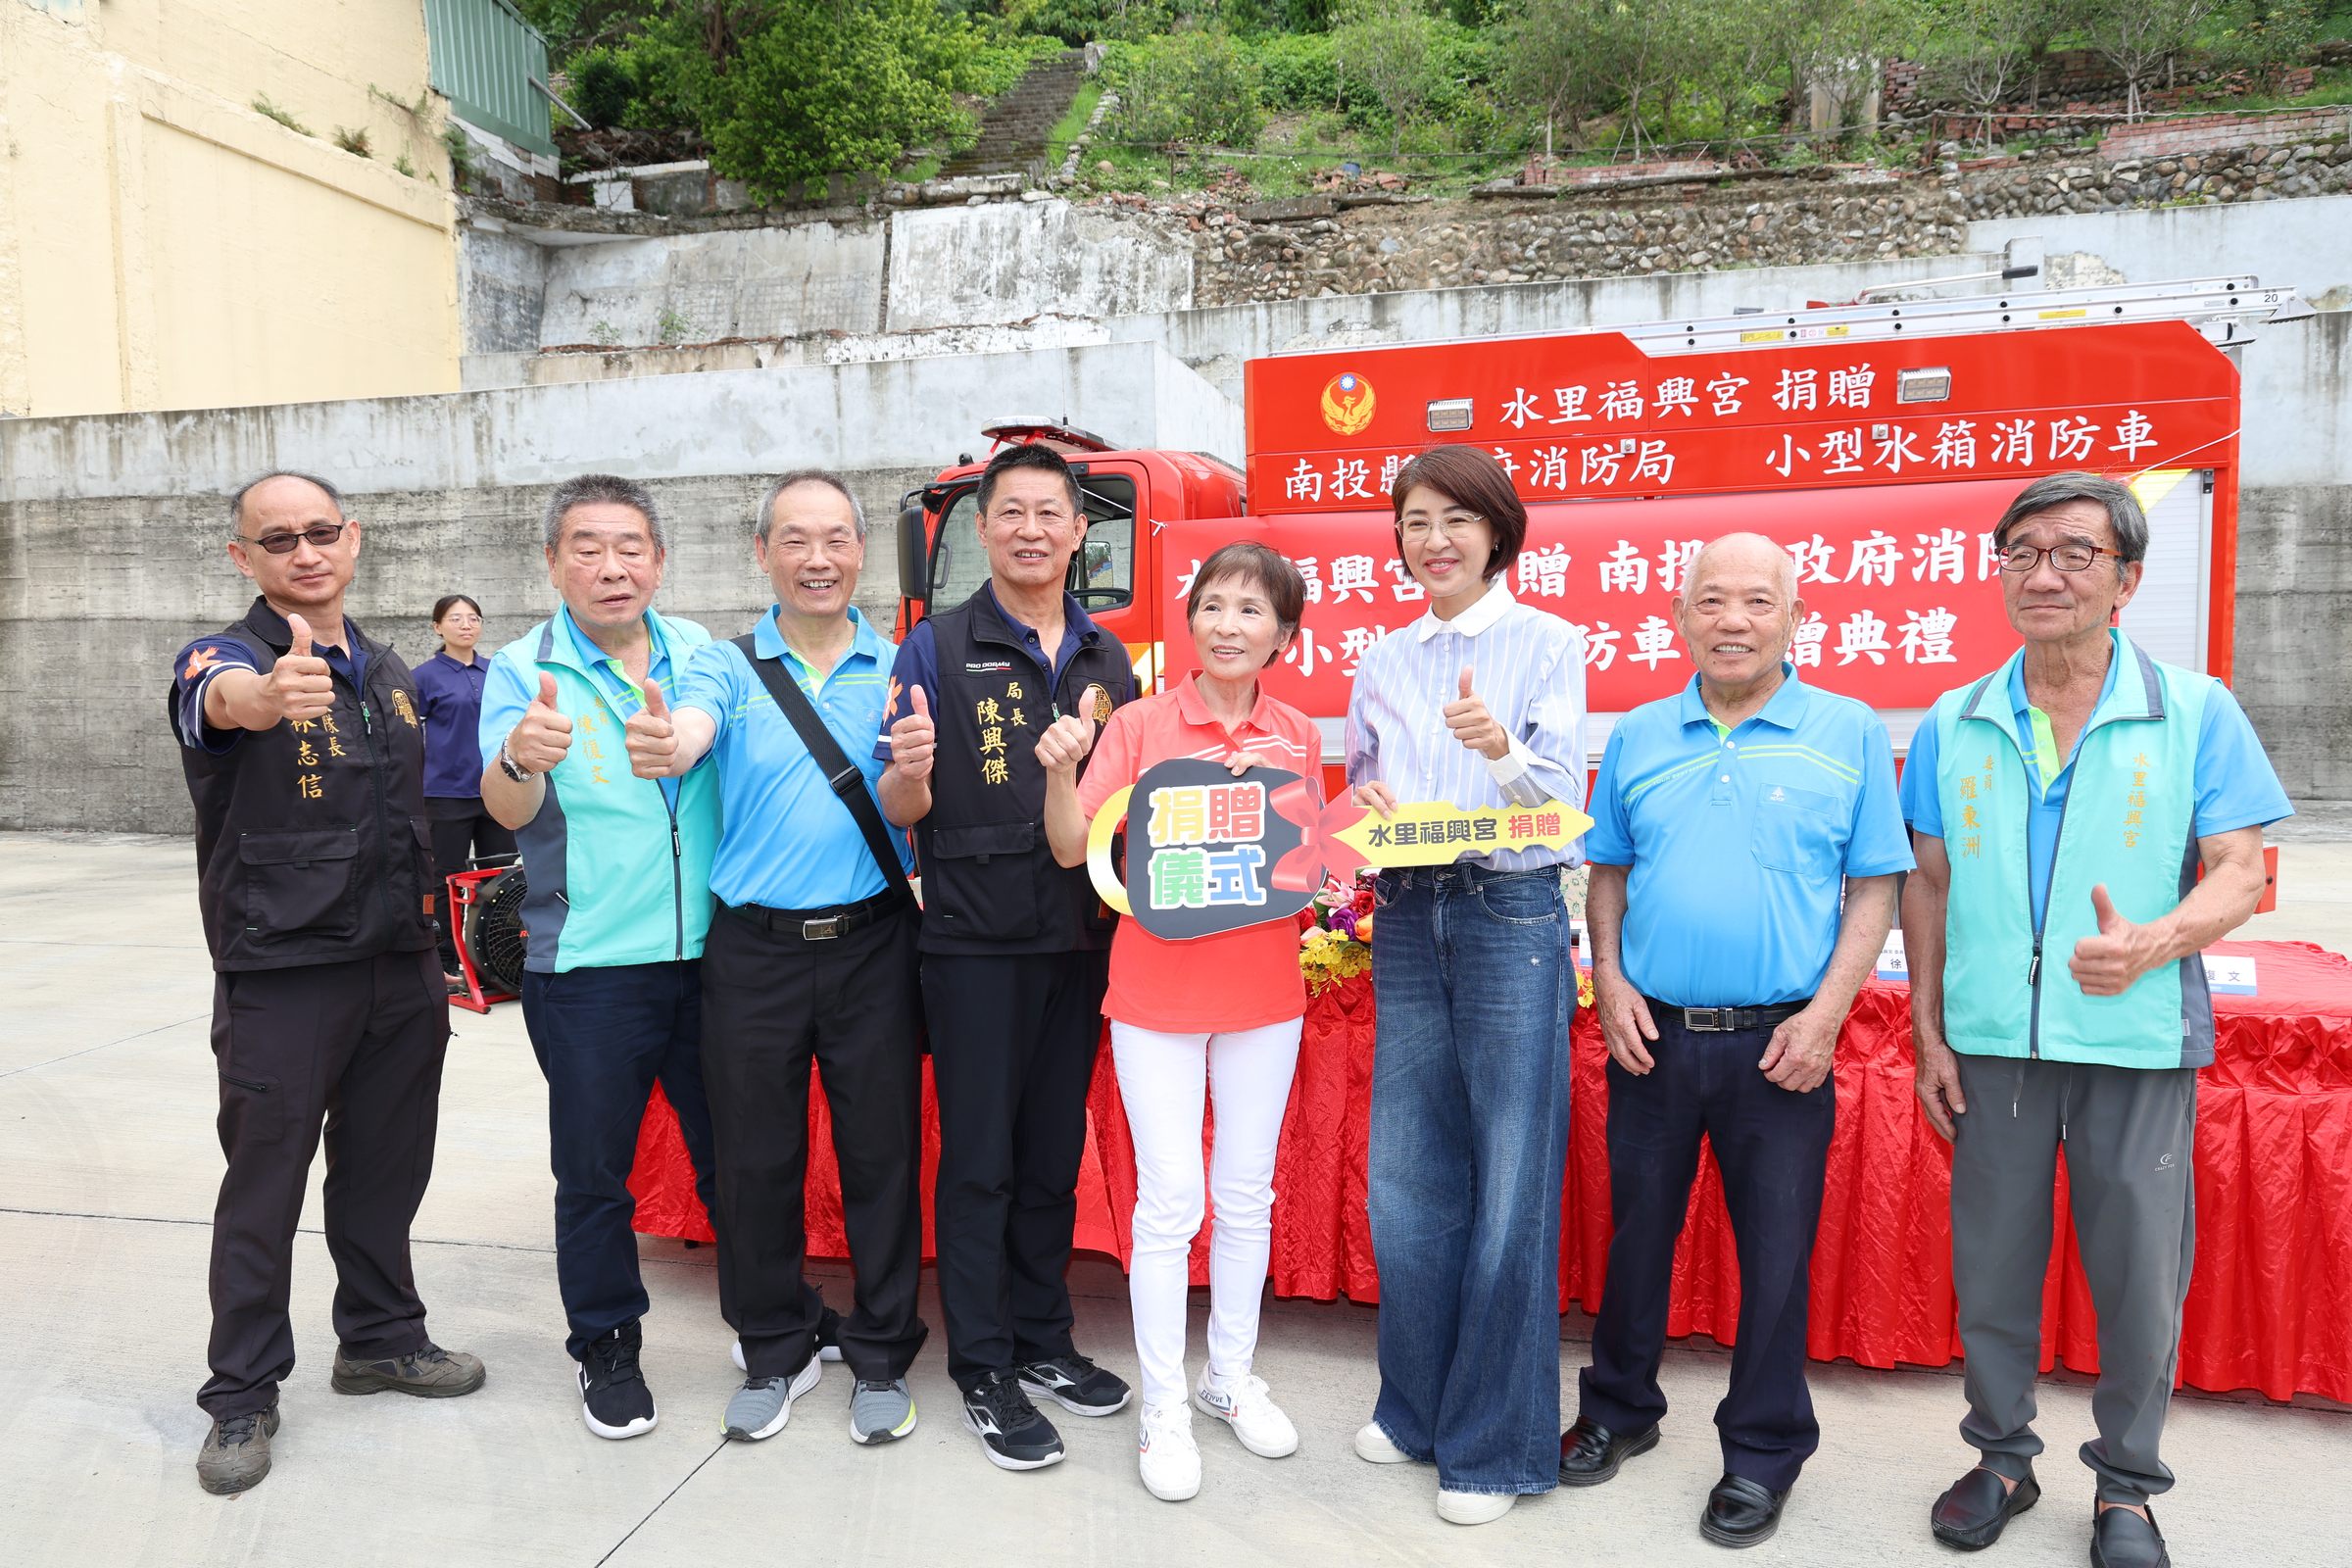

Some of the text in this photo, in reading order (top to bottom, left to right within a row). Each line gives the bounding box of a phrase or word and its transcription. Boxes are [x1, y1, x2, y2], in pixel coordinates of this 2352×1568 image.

[2264, 293, 2278, 303] 20
[1499, 362, 1876, 429] 水里福興宮 捐贈
[1765, 409, 2159, 478] 小型水箱消防車
[1516, 542, 1572, 598] 贈
[1598, 526, 2000, 596] 南投政府消
[1784, 606, 1959, 668] 贈典禮
[320, 708, 347, 758] 隊長
[1005, 681, 1028, 727] 局長
[976, 697, 1008, 785] 陳興傑
[1149, 782, 1264, 847] 捐贈
[1368, 812, 1561, 848] 水里福興宮 捐贈
[1960, 775, 1981, 859] 羅東洲
[2123, 752, 2150, 849] 水里福興宮
[1149, 846, 1265, 908] 儀式
[1889, 958, 1902, 969] 徐
